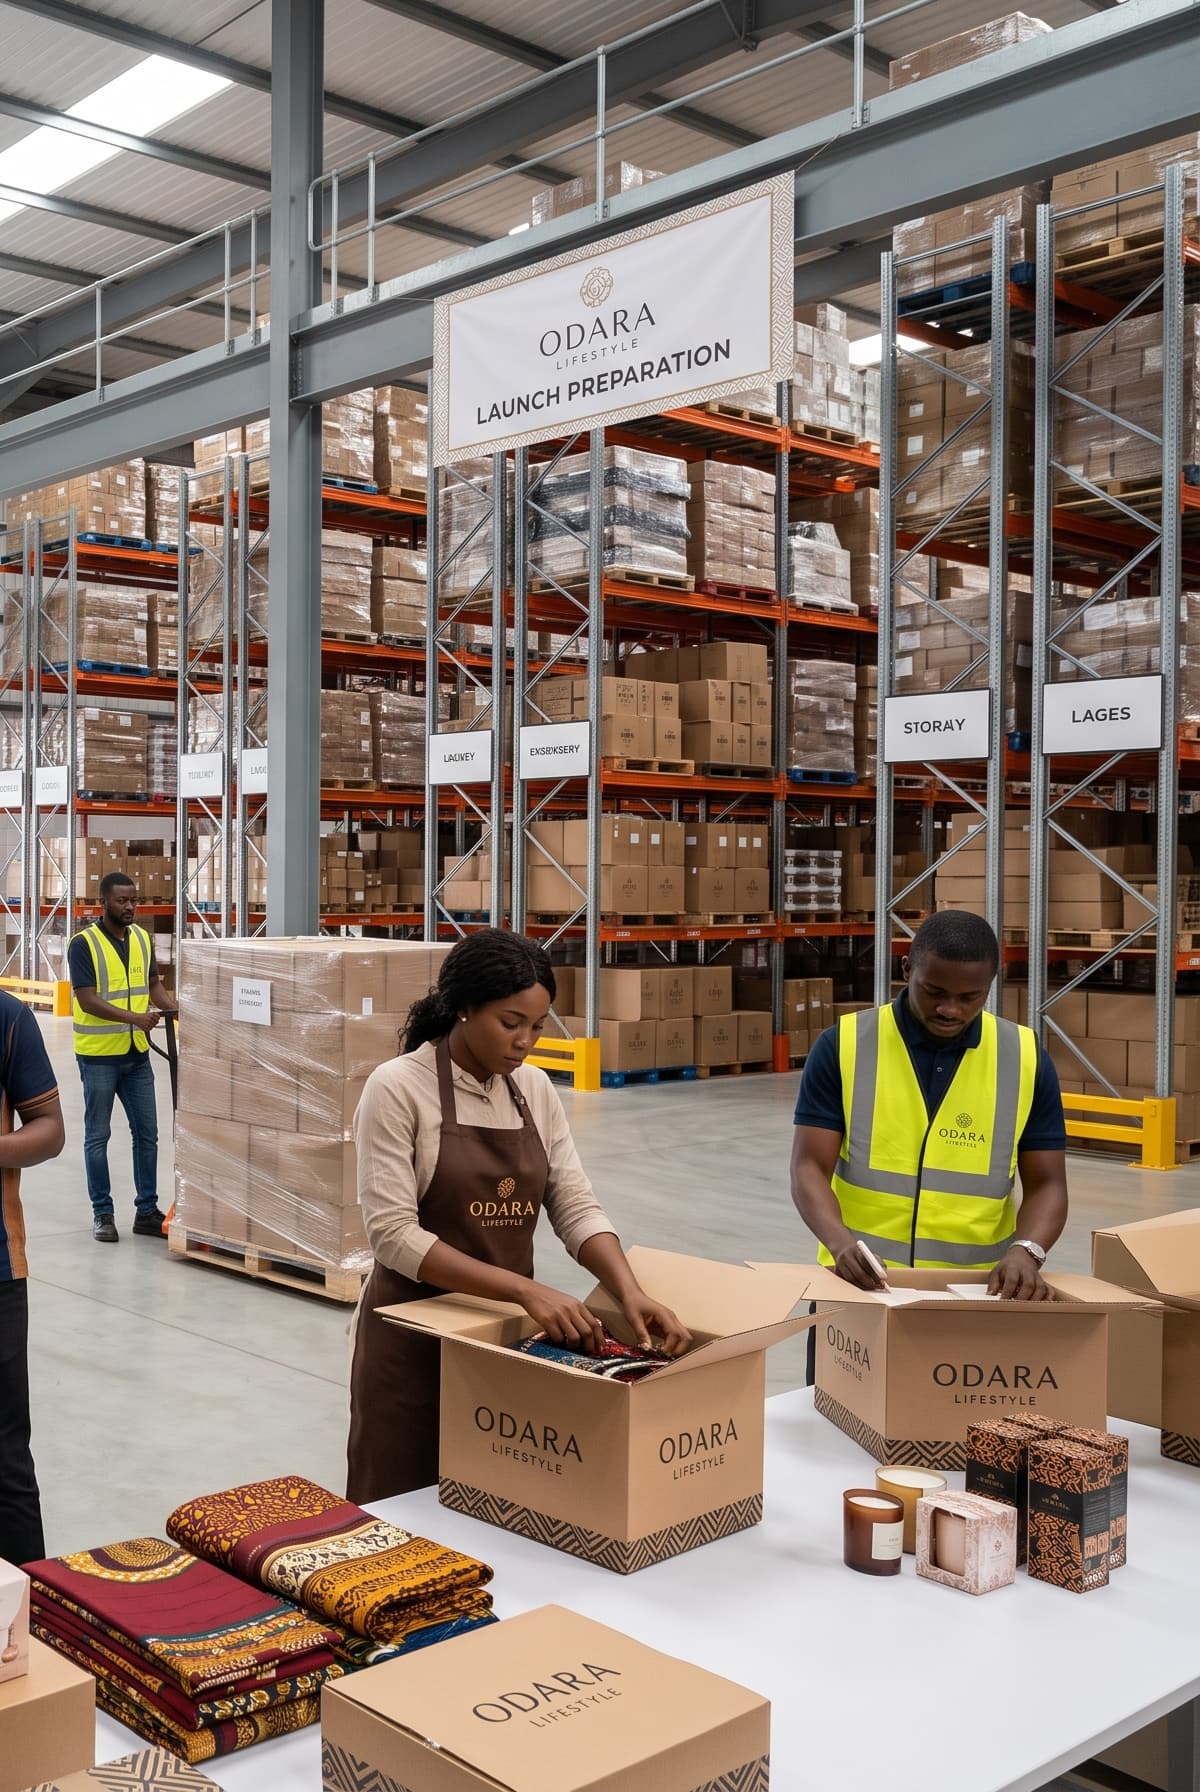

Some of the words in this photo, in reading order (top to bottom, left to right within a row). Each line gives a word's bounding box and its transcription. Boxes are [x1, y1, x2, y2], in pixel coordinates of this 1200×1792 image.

[539, 302, 656, 357] ODARA
[555, 338, 639, 370] LIFESTYLE
[476, 386, 560, 425] LAUNCH
[567, 339, 731, 402] PREPARATION
[1071, 707, 1131, 723] LAGES
[939, 1128, 985, 1142] ODARA
[469, 1200, 535, 1217] ODARA
[481, 1219, 524, 1227] LIFESTYLE
[826, 1324, 871, 1371] ODARA
[932, 1363, 1059, 1390] ODARA
[954, 1394, 1036, 1406] LIFESTYLE
[474, 1406, 583, 1463] ODARA
[659, 1417, 738, 1464] ODARA
[491, 1441, 563, 1475] LIFESTYLE
[673, 1454, 725, 1480] LIFESTYLE
[472, 1663, 622, 1723] ODARA
[529, 1687, 622, 1728] LIFESTYLE
